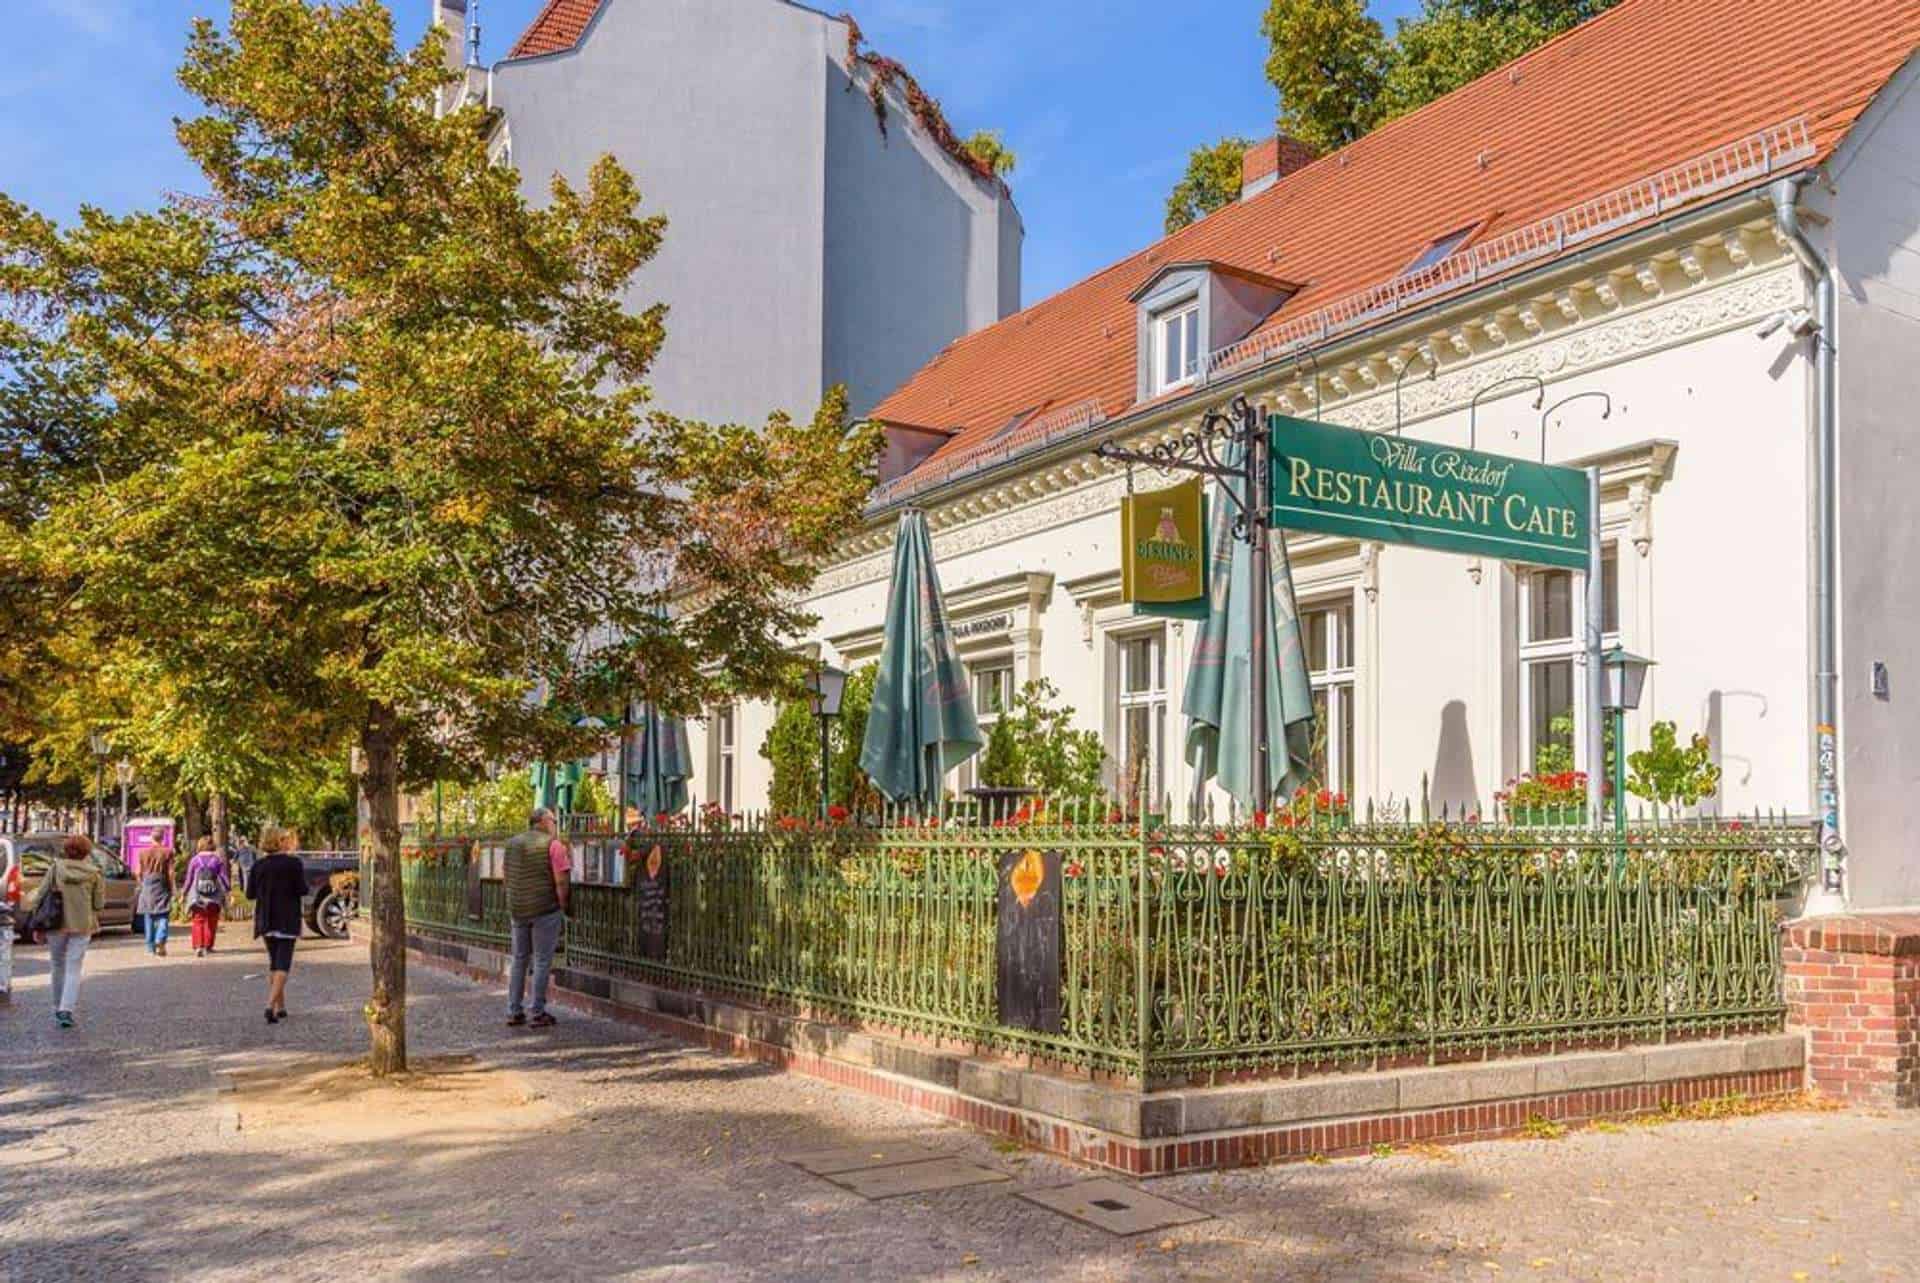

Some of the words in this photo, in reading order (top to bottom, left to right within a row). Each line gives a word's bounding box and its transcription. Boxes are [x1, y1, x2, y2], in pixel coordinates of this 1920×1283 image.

[1288, 456, 1495, 526] RESTAURANT
[1371, 436, 1426, 473] Villa
[1431, 451, 1514, 497] Rixdorf
